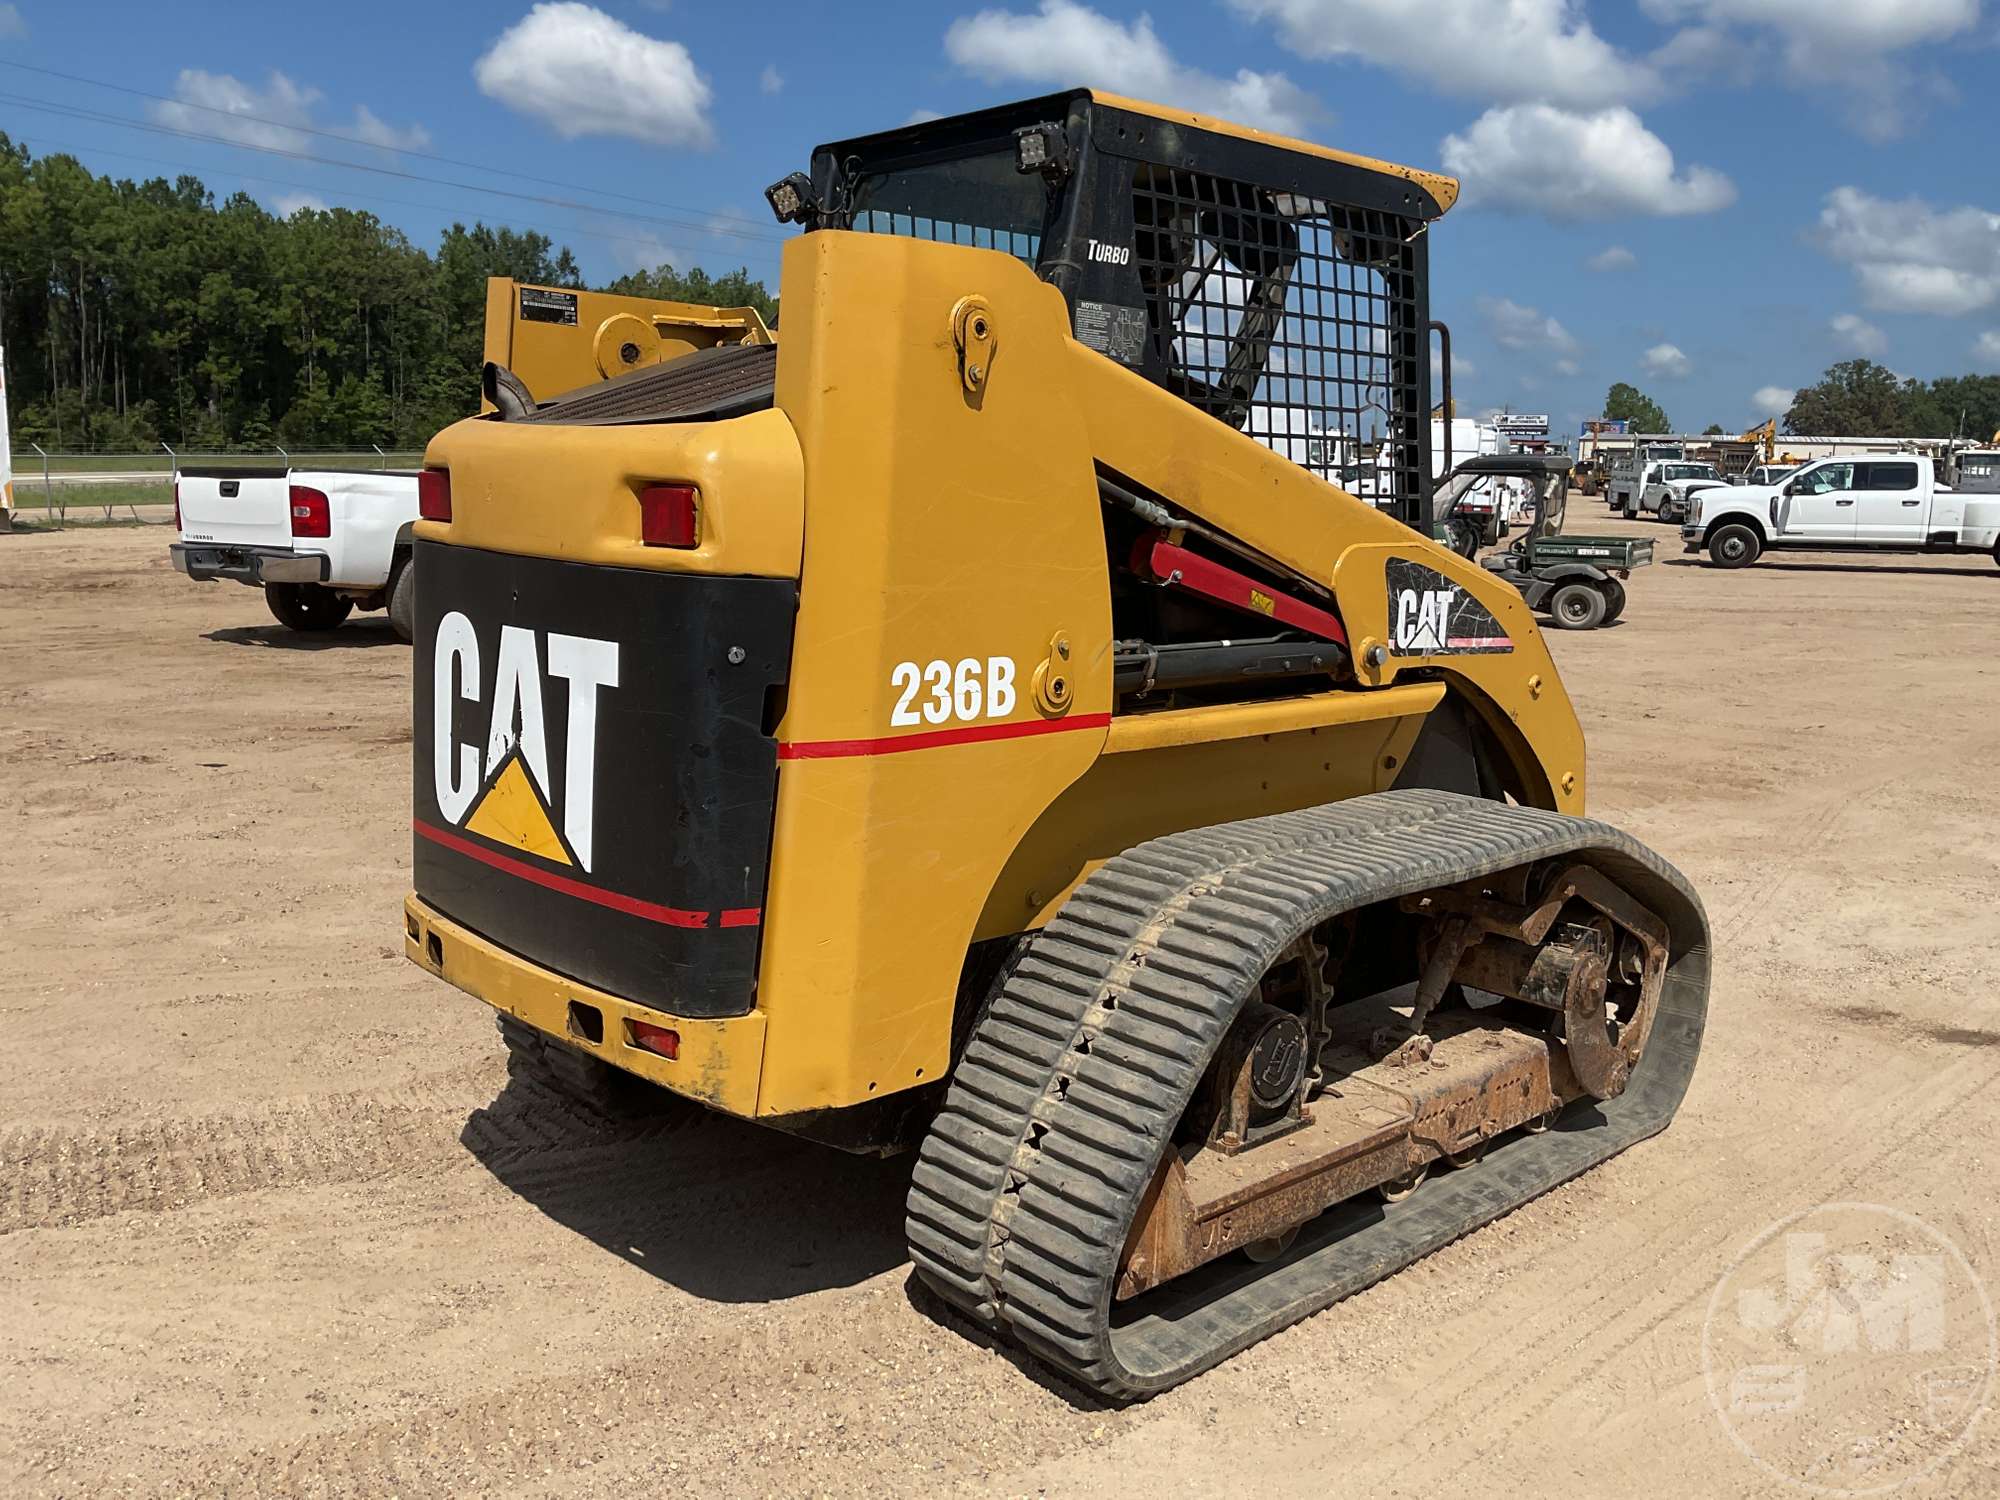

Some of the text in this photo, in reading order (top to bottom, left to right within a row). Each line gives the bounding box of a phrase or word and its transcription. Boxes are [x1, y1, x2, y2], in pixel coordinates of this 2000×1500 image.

[1087, 239, 1130, 265] TURBO
[1080, 301, 1103, 311] NOTICE
[1396, 588, 1455, 650] CAT
[890, 656, 1017, 727] 236B
[434, 611, 619, 873] CAT
